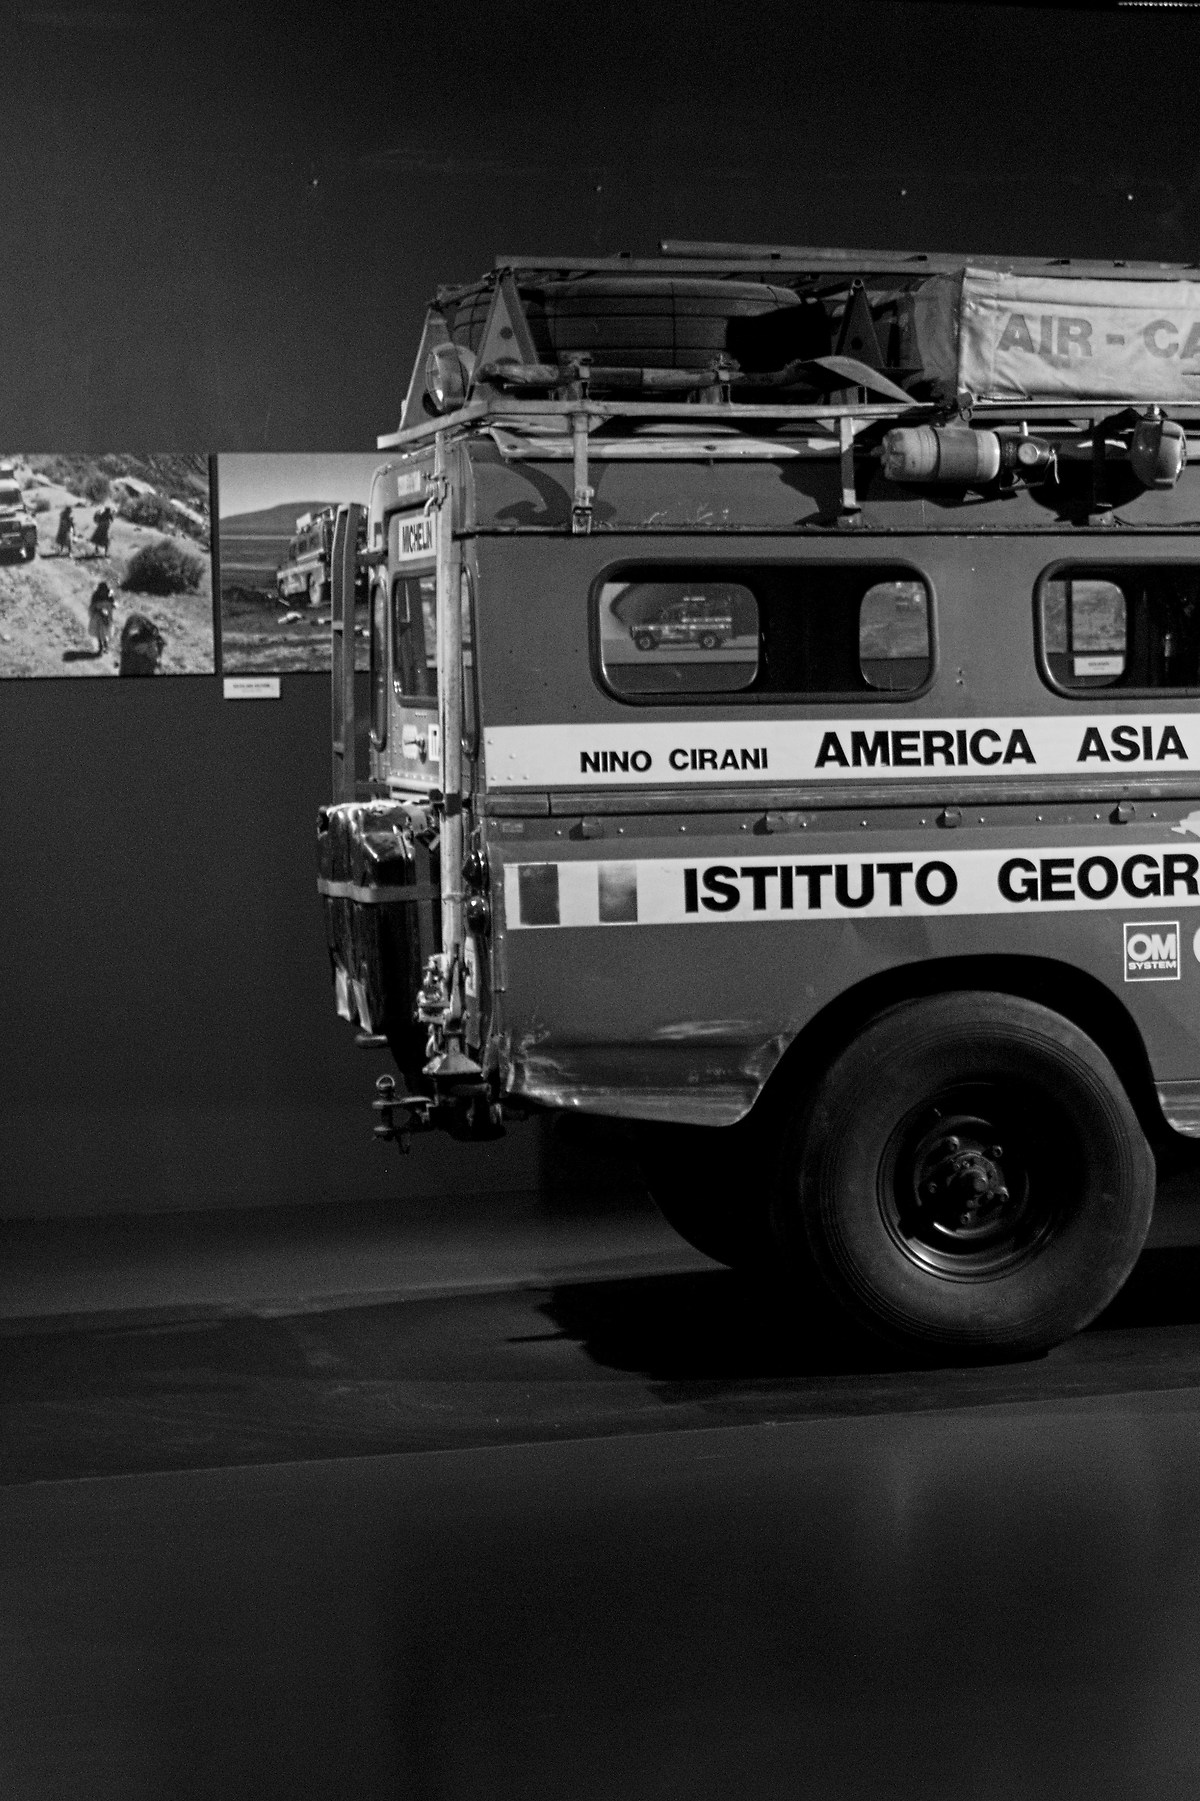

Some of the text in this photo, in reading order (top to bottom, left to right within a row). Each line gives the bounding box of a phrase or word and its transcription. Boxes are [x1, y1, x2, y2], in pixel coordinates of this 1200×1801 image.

[1000, 314, 1093, 357] AIR
[580, 750, 652, 773] NINO
[668, 747, 768, 771] CIRANI
[814, 728, 1037, 768] AMERICA
[1076, 724, 1188, 763] ASIA
[684, 860, 958, 914] ISTITUTO
[1127, 932, 1177, 961] OM
[1128, 961, 1177, 971] SYSTEM
